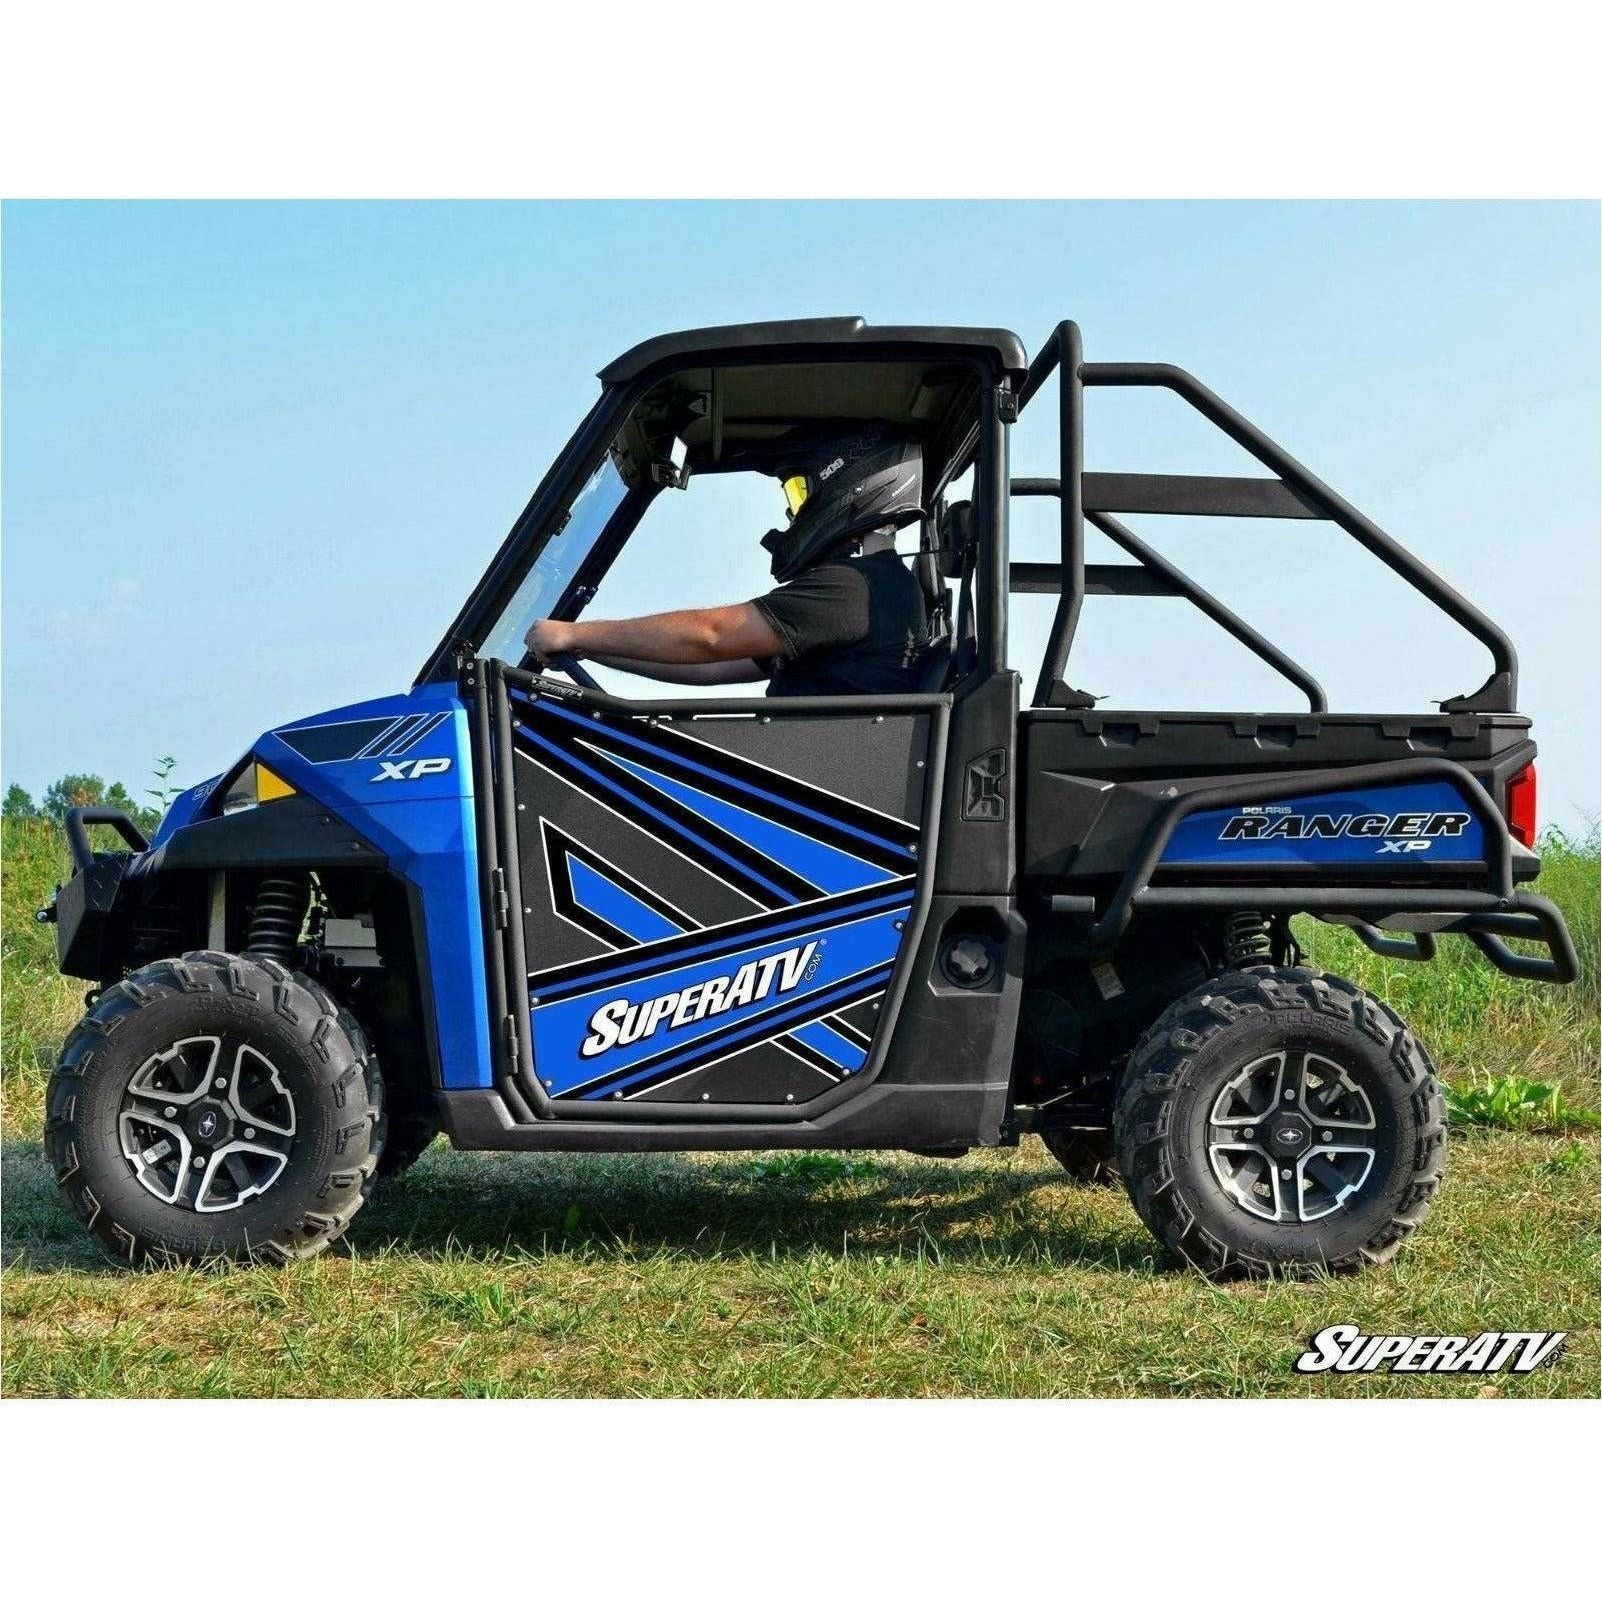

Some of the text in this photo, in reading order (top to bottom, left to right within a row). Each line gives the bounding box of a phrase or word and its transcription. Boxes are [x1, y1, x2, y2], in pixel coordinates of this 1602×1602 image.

[369, 757, 452, 781] XP
[1218, 813, 1471, 840] RANGER
[1374, 840, 1432, 853] XP
